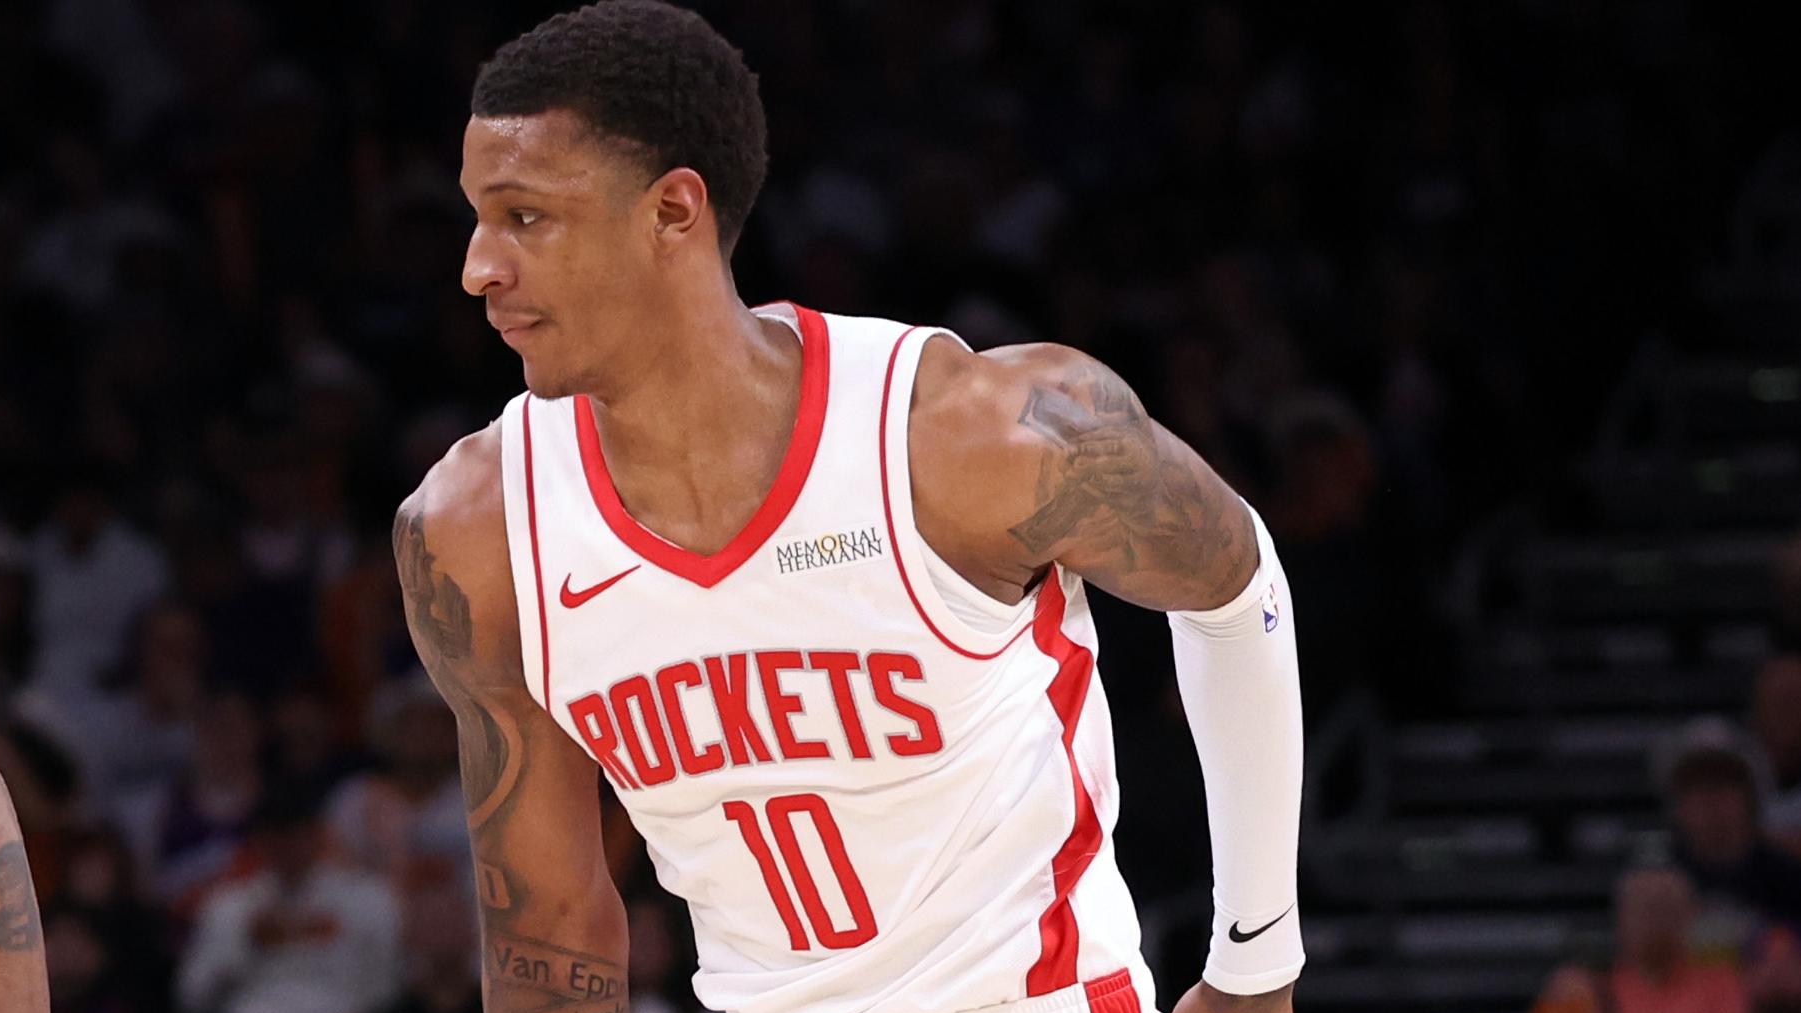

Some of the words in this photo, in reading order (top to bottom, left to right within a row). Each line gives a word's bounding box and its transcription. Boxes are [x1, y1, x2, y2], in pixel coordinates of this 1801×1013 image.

[776, 526, 883, 559] MEMORIAL
[778, 539, 883, 574] HERMANN
[567, 648, 946, 792] ROCKETS
[721, 792, 879, 952] 10
[494, 945, 549, 983] Van
[568, 961, 628, 999] Epp
